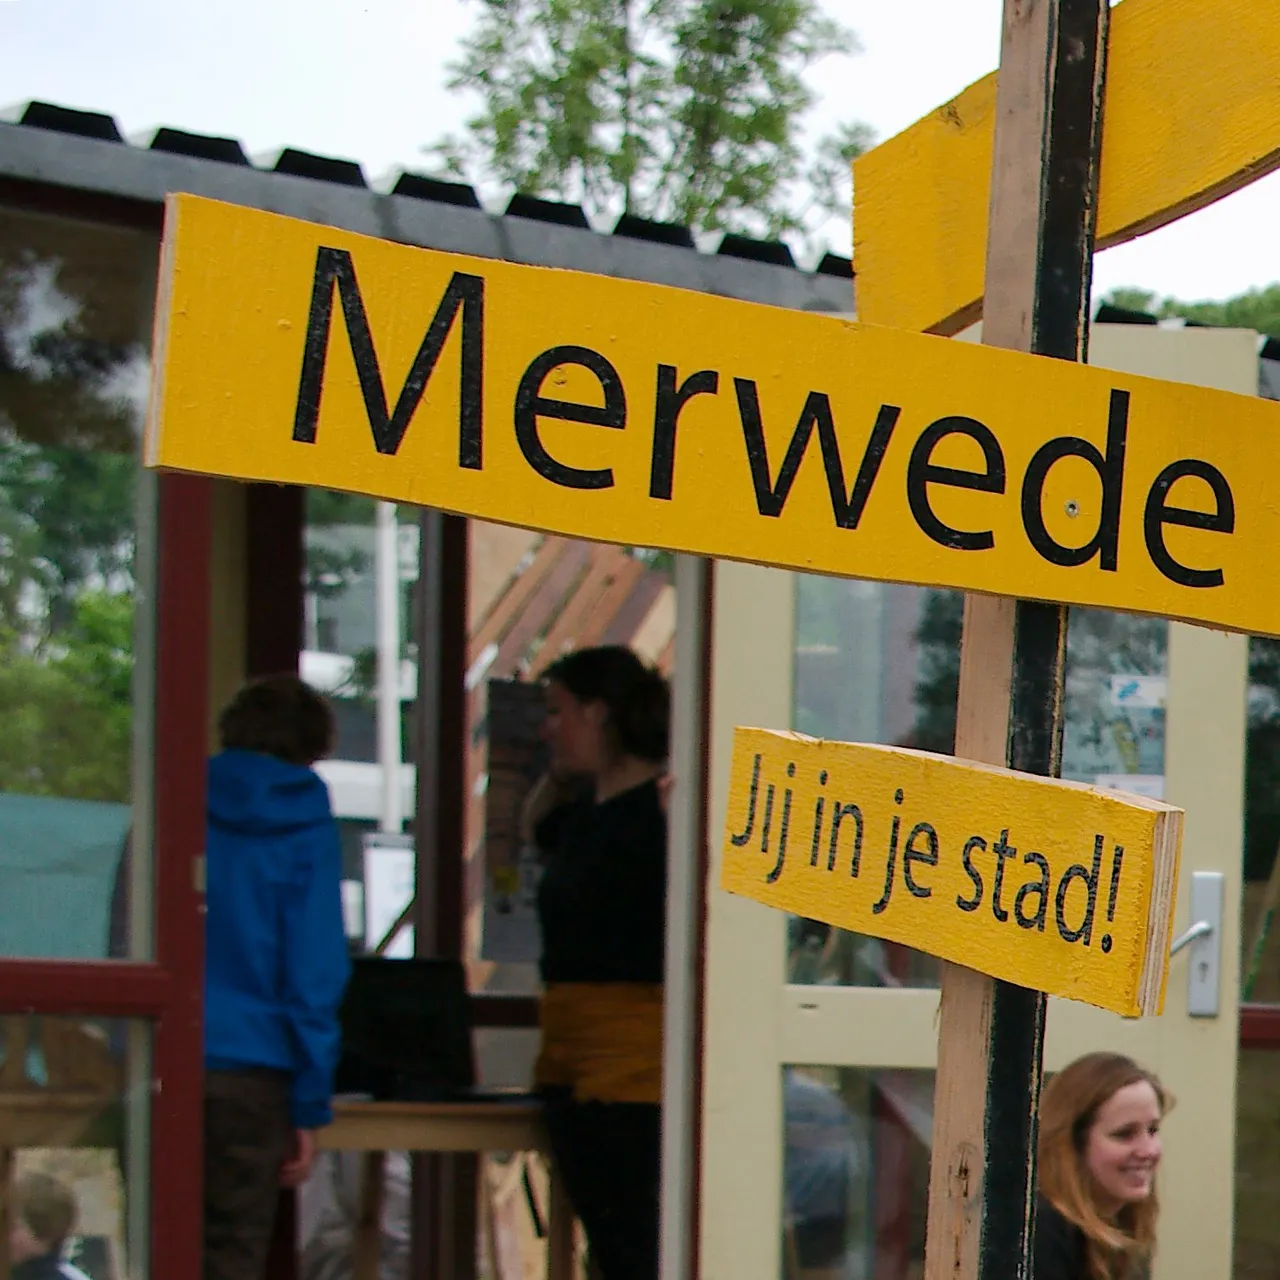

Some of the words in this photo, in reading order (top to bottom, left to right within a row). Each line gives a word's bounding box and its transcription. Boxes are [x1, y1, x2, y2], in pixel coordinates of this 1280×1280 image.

[291, 245, 1236, 589] Merwede
[730, 754, 796, 884] Jij
[809, 771, 864, 879] in
[872, 788, 940, 915] je
[955, 828, 1125, 955] stad!
